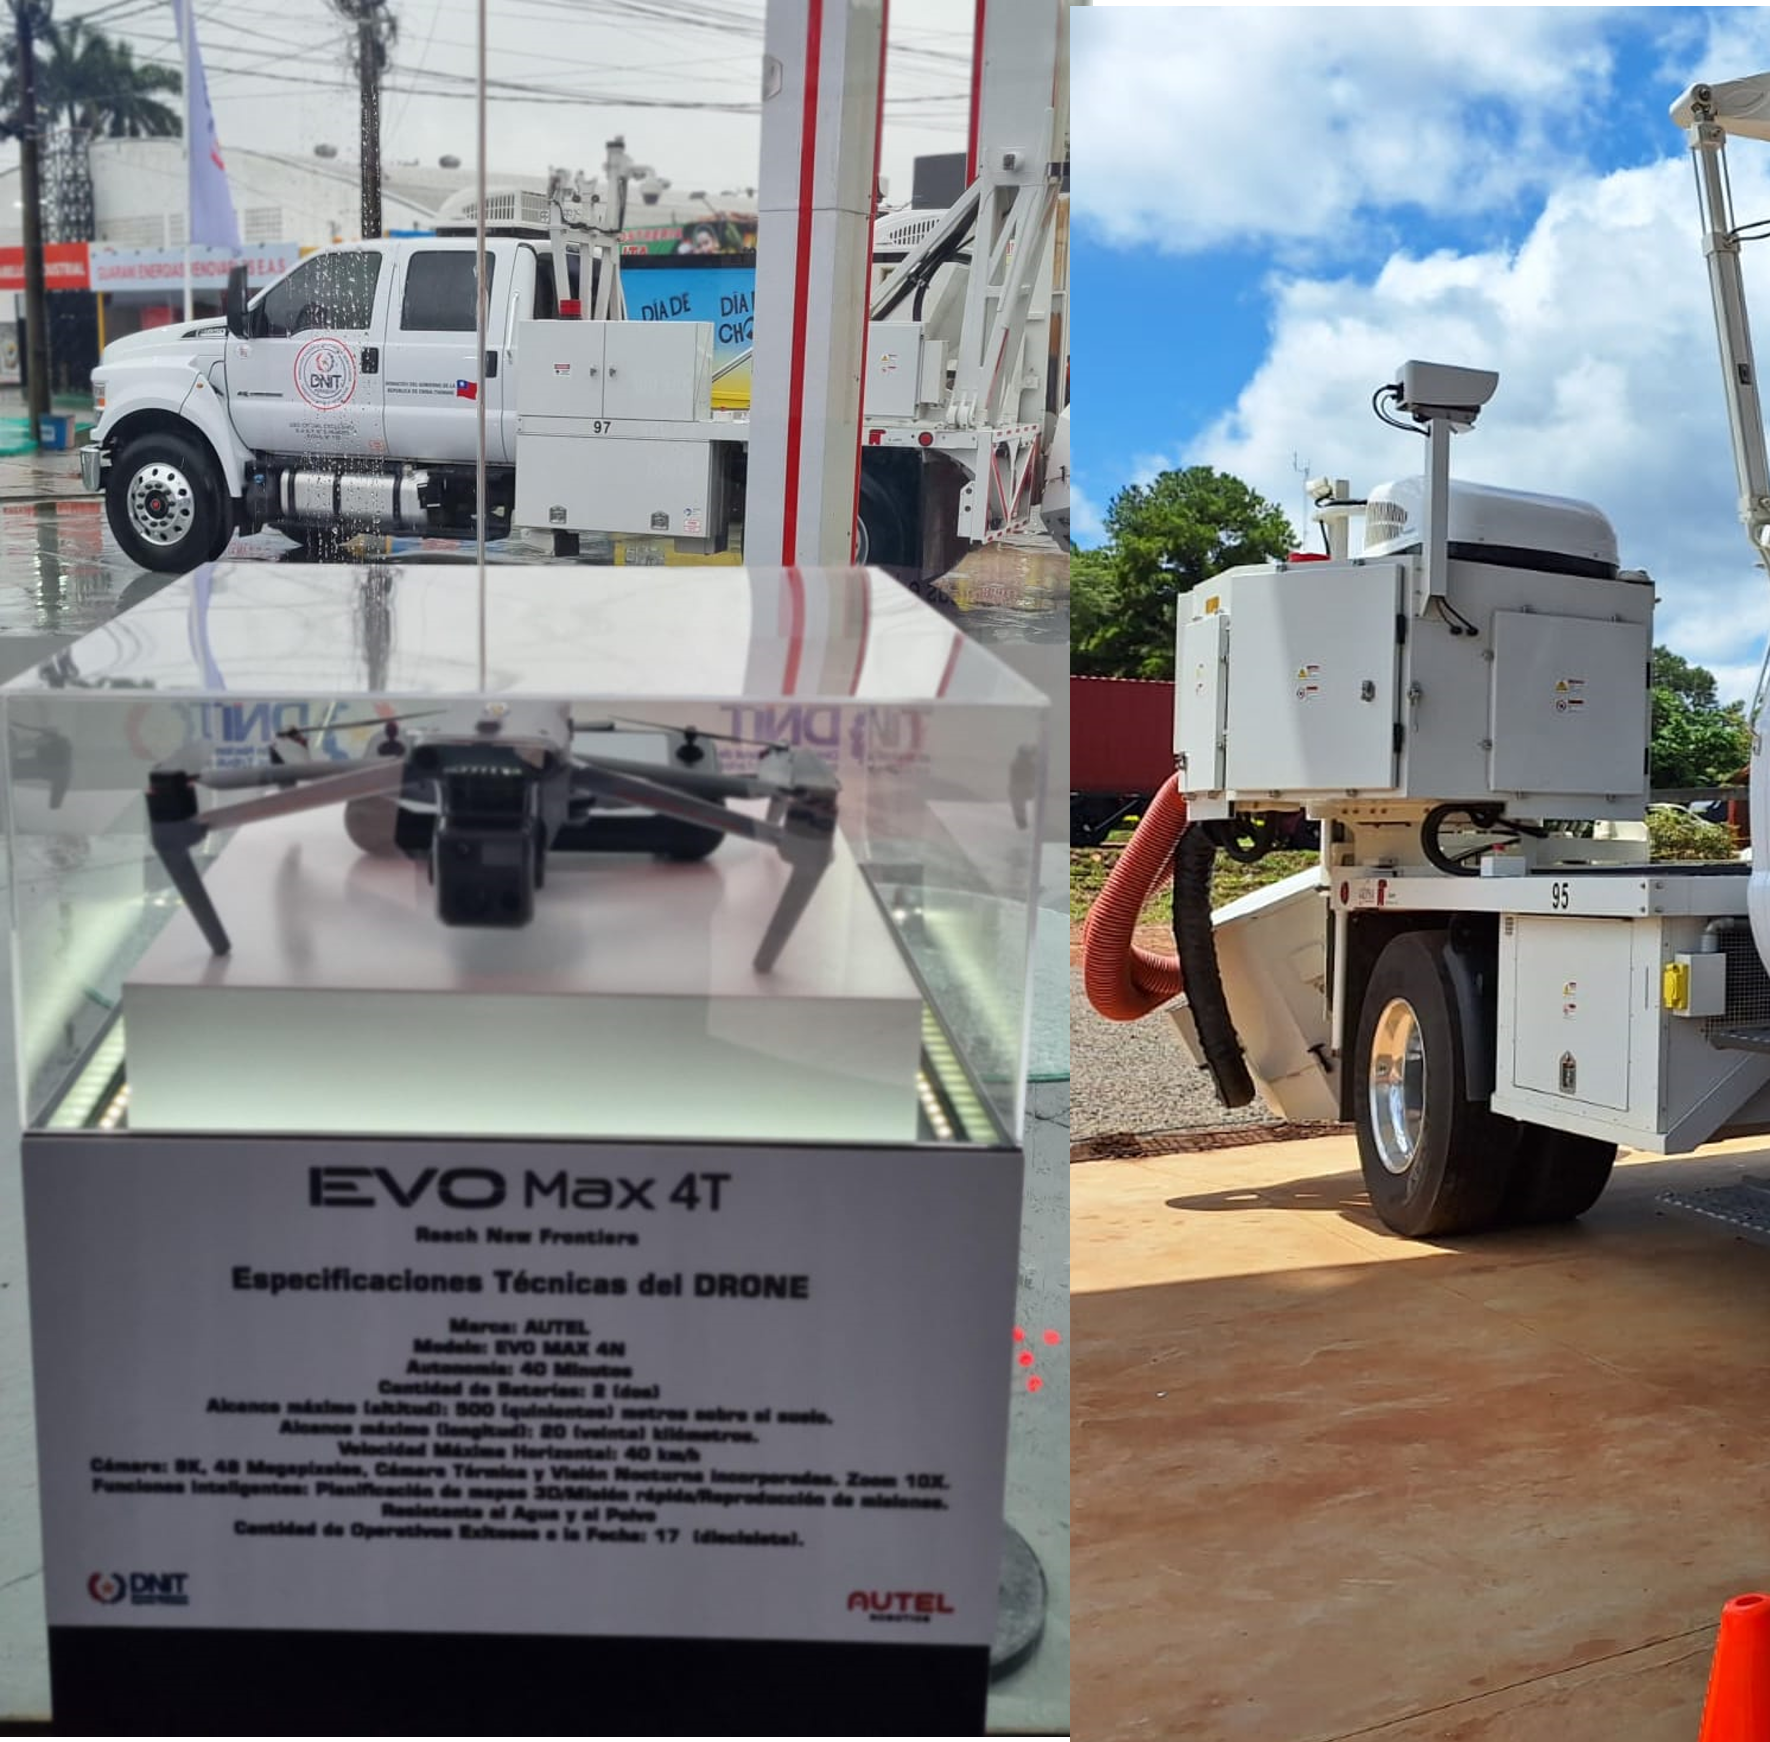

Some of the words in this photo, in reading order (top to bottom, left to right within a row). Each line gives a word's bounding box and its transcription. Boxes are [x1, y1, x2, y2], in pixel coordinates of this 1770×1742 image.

[669, 292, 692, 316] DE
[720, 291, 749, 317] DÍA
[593, 420, 612, 434] 97
[1552, 882, 1569, 909] 95
[308, 1165, 508, 1209] EVO
[523, 1170, 656, 1211] Max
[668, 1172, 732, 1212] 4T
[414, 1225, 479, 1244] Reach
[485, 1226, 533, 1245] New
[538, 1228, 640, 1247] Frontiers
[231, 1266, 484, 1298] Especificaciones
[492, 1269, 628, 1295] Técnicas
[637, 1271, 683, 1297] del
[693, 1273, 810, 1300] DRONE
[130, 1571, 189, 1594] DNIT
[846, 1590, 955, 1614] AUTEL
